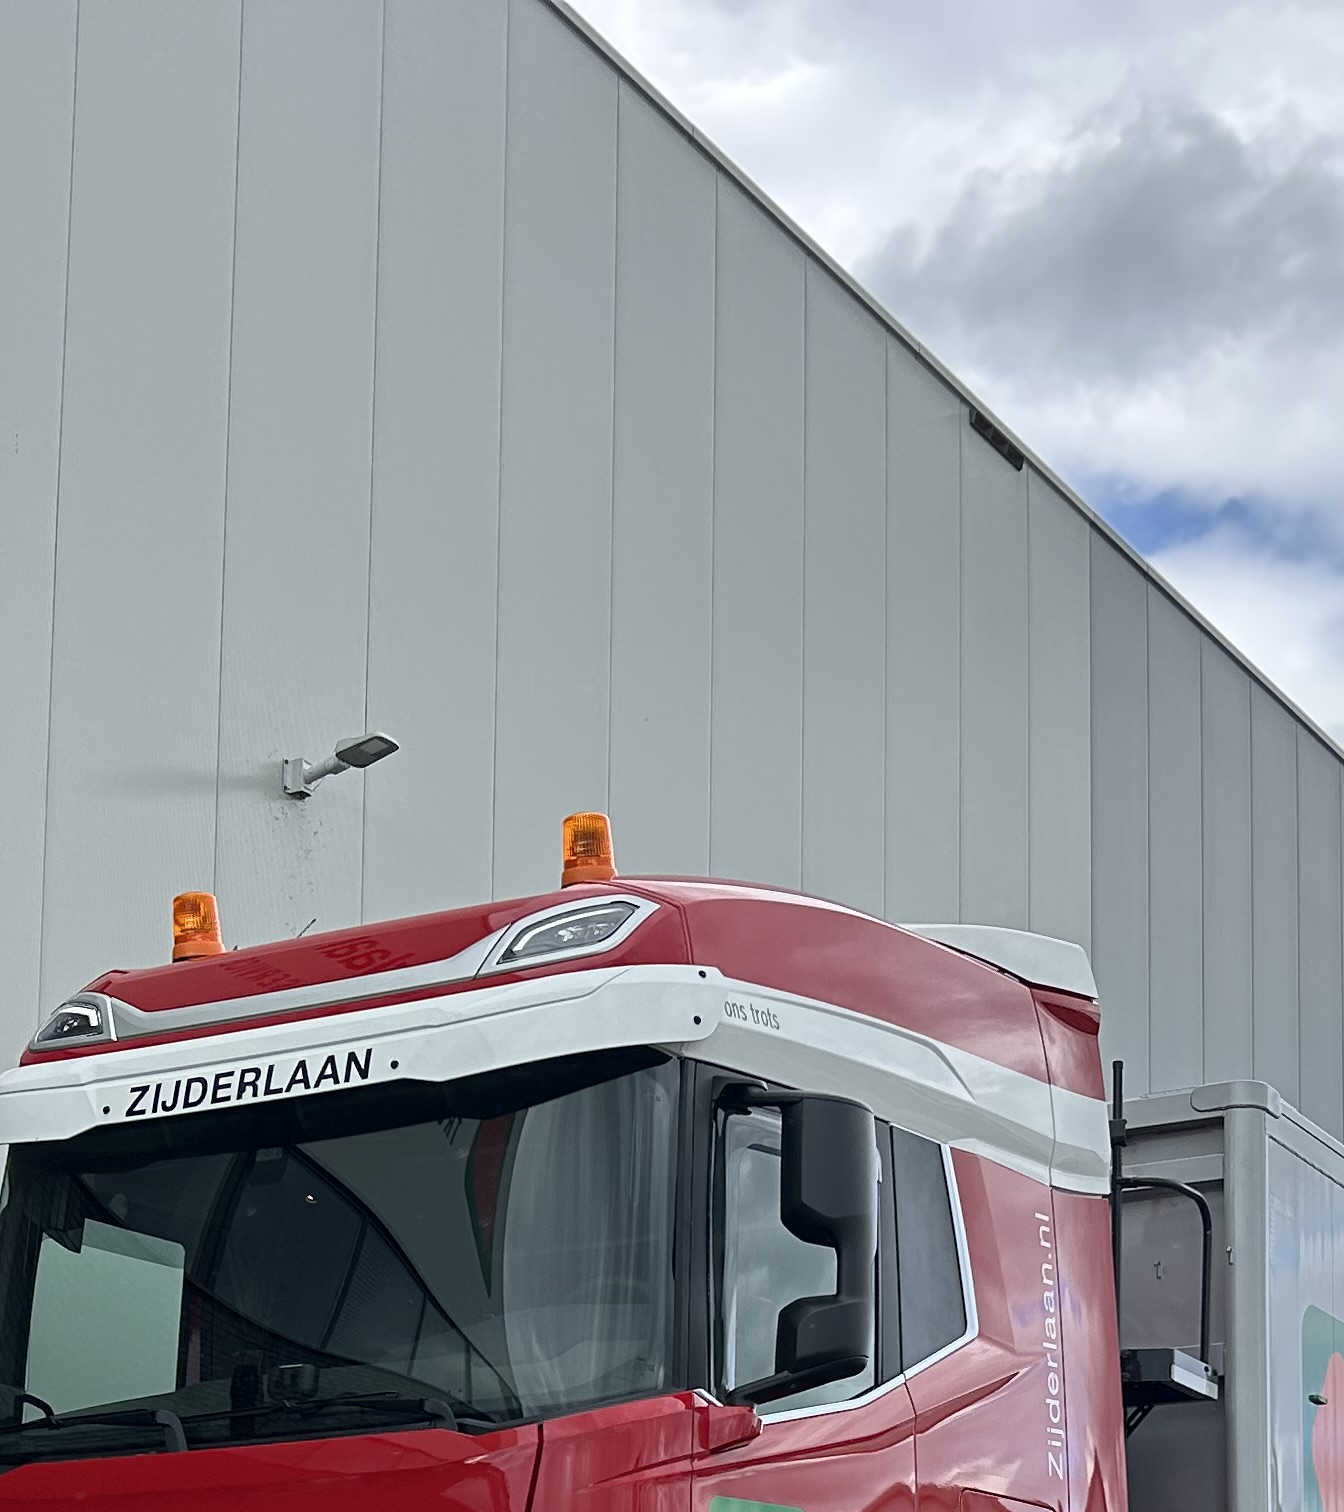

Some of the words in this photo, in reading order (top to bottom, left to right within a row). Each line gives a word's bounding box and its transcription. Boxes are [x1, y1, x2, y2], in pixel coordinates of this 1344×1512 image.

[724, 1001, 747, 1021] ons
[749, 1002, 780, 1030] trots
[125, 1048, 373, 1118] ZIJDERLAAN
